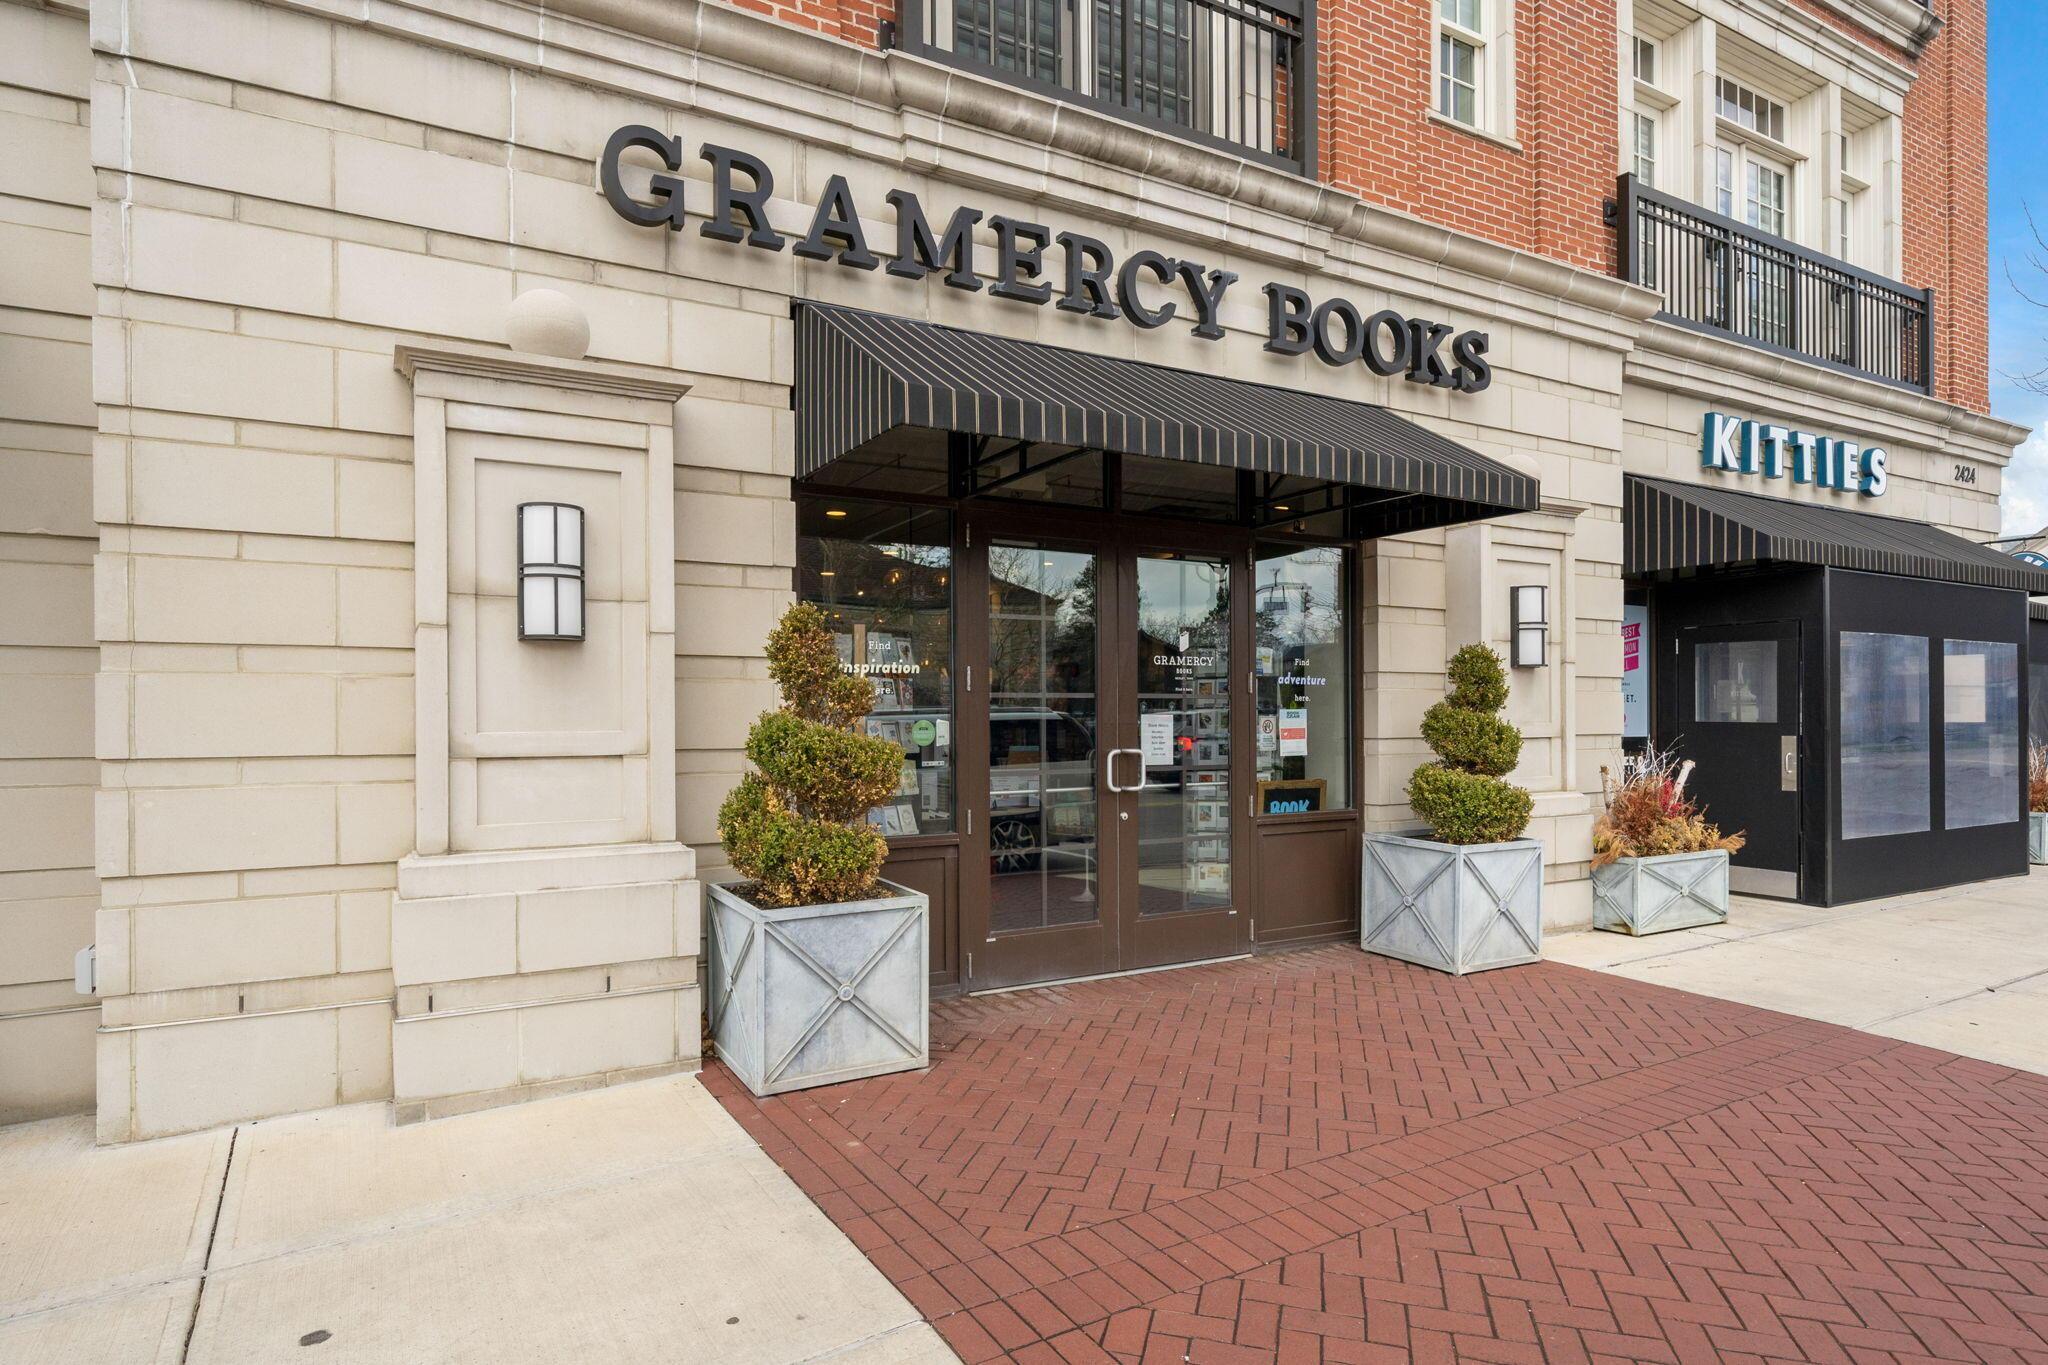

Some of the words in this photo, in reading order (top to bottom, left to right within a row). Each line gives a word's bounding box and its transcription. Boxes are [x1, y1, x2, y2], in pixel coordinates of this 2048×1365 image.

[601, 124, 1239, 341] GRAMERCY
[1262, 282, 1492, 394] BOOKS
[1703, 412, 1887, 497] KITTIES
[1954, 464, 1976, 484] 2424
[868, 641, 891, 650] Find
[1153, 655, 1214, 667] GRAMERCY
[1294, 658, 1310, 666] Find
[1278, 672, 1326, 686] adventure
[874, 686, 894, 695] ere.
[1294, 694, 1311, 702] here.
[1270, 799, 1310, 814] BOOK
